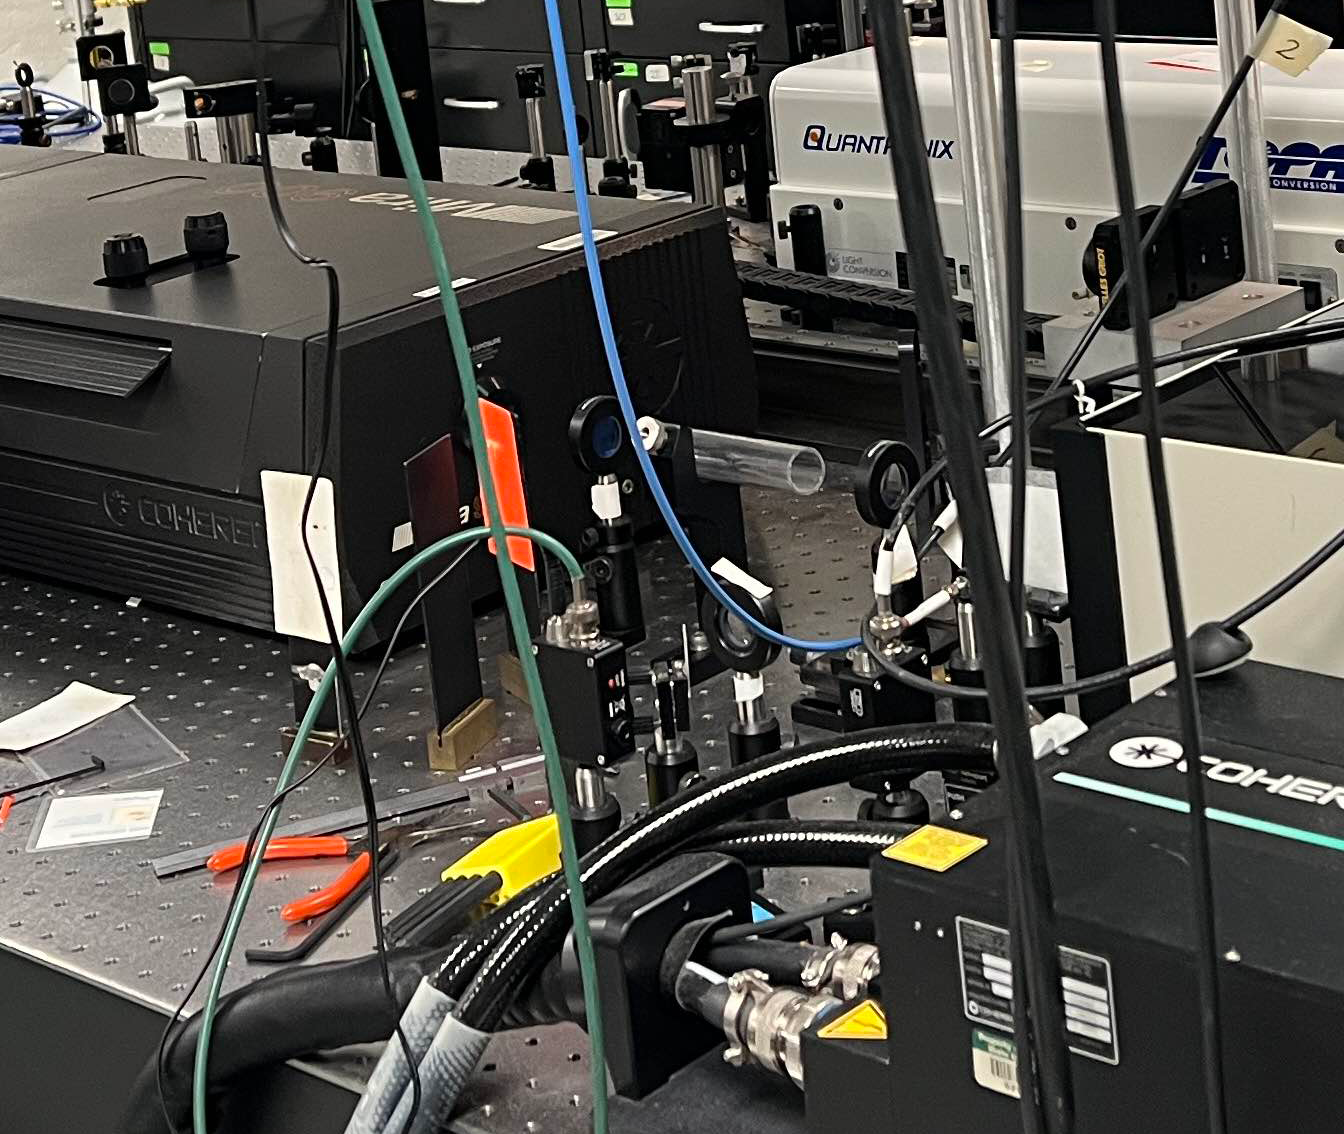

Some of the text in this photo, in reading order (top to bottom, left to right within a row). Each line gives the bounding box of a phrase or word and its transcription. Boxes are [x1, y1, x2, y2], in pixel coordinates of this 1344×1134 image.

[1275, 39, 1300, 60] 2
[803, 124, 955, 160] QUANTIX
[1272, 177, 1338, 192] ONVERSION
[137, 498, 263, 548] COHERE
